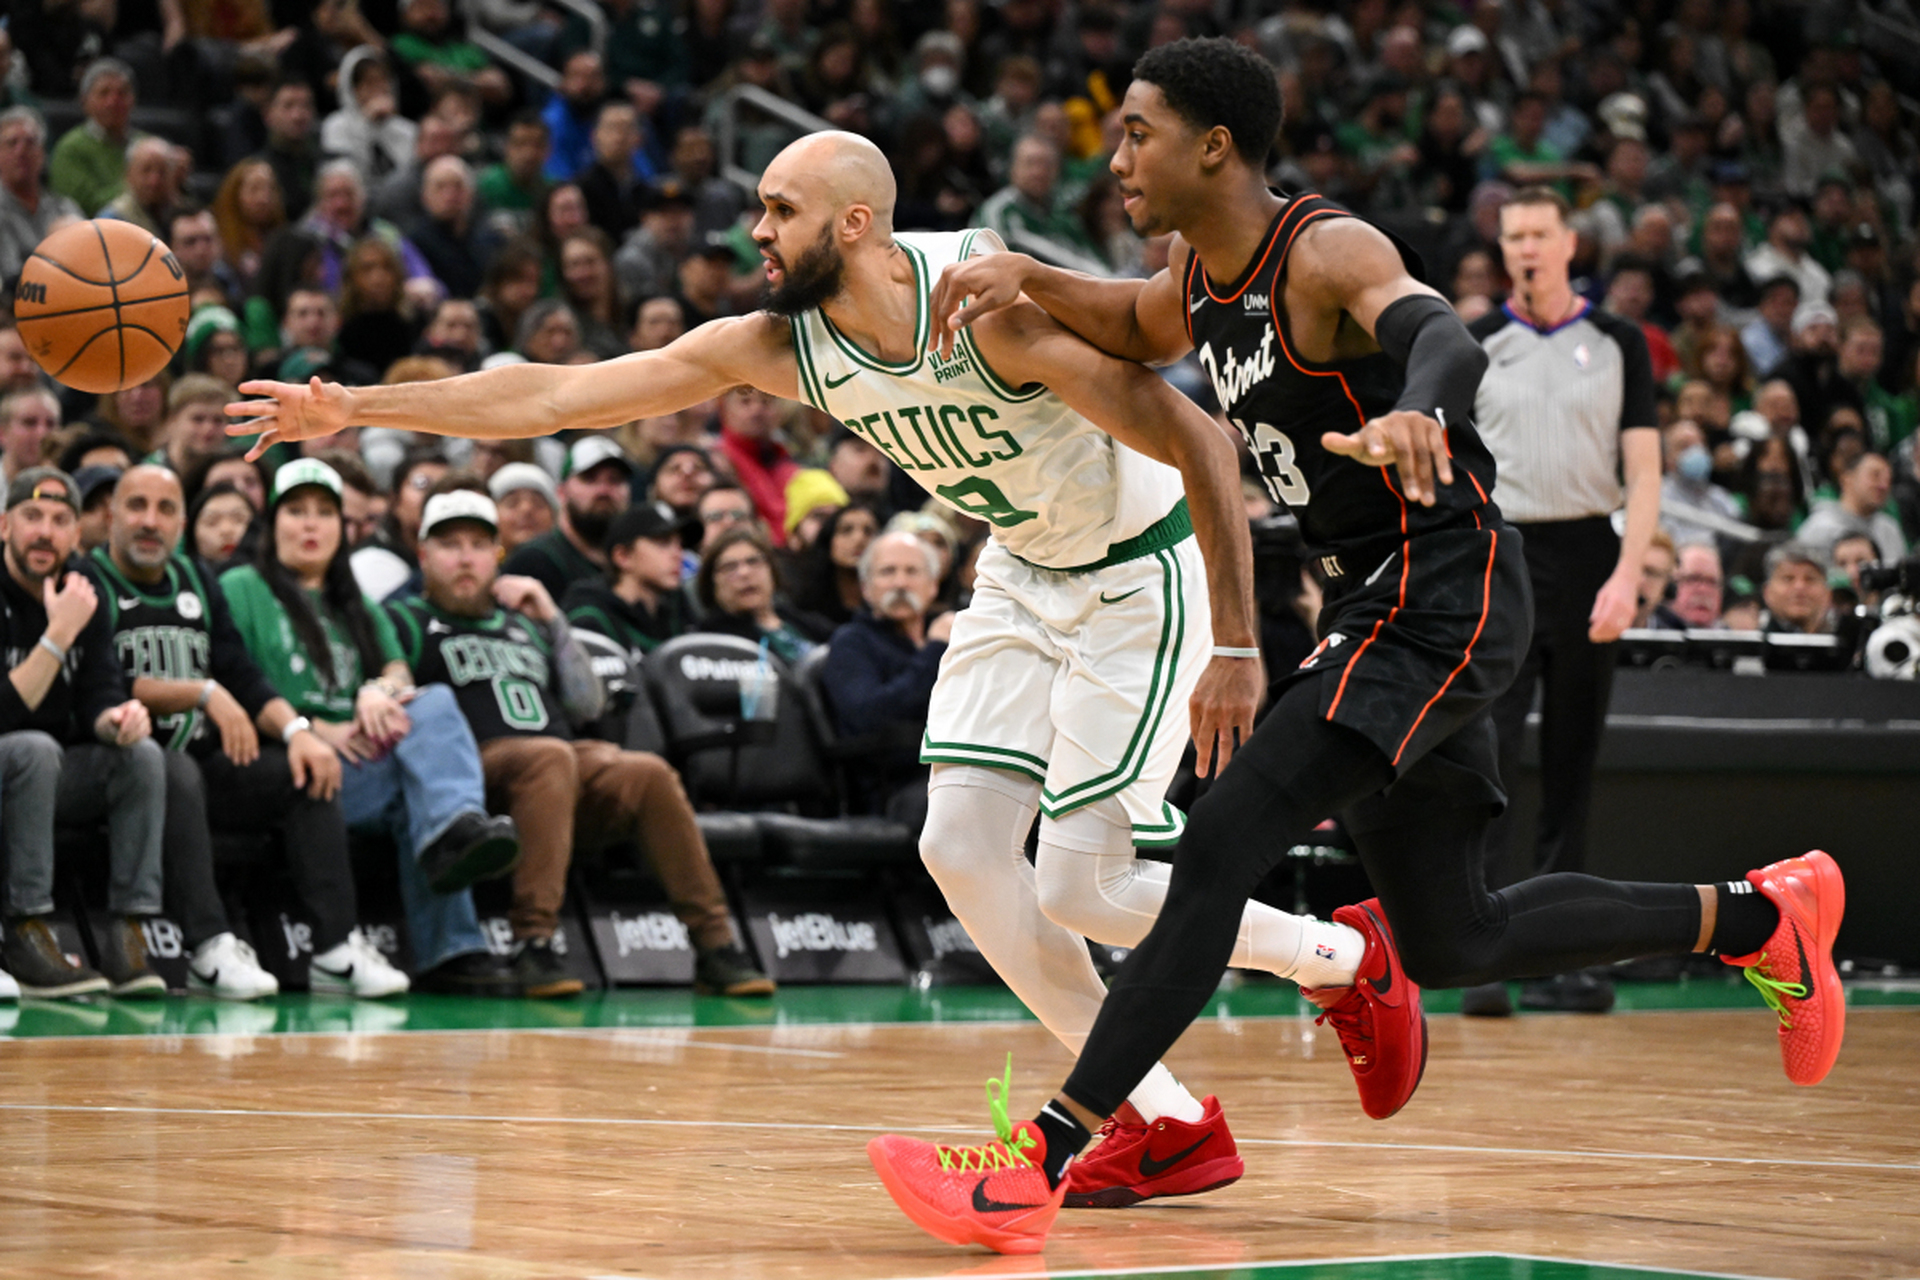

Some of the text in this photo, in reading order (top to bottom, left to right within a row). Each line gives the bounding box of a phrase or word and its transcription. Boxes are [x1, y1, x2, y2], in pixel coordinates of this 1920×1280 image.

[1243, 293, 1269, 310] UWM
[928, 343, 967, 371] VITA
[934, 360, 971, 384] PRINT
[490, 675, 551, 732] 0
[768, 912, 878, 959] jetBlue
